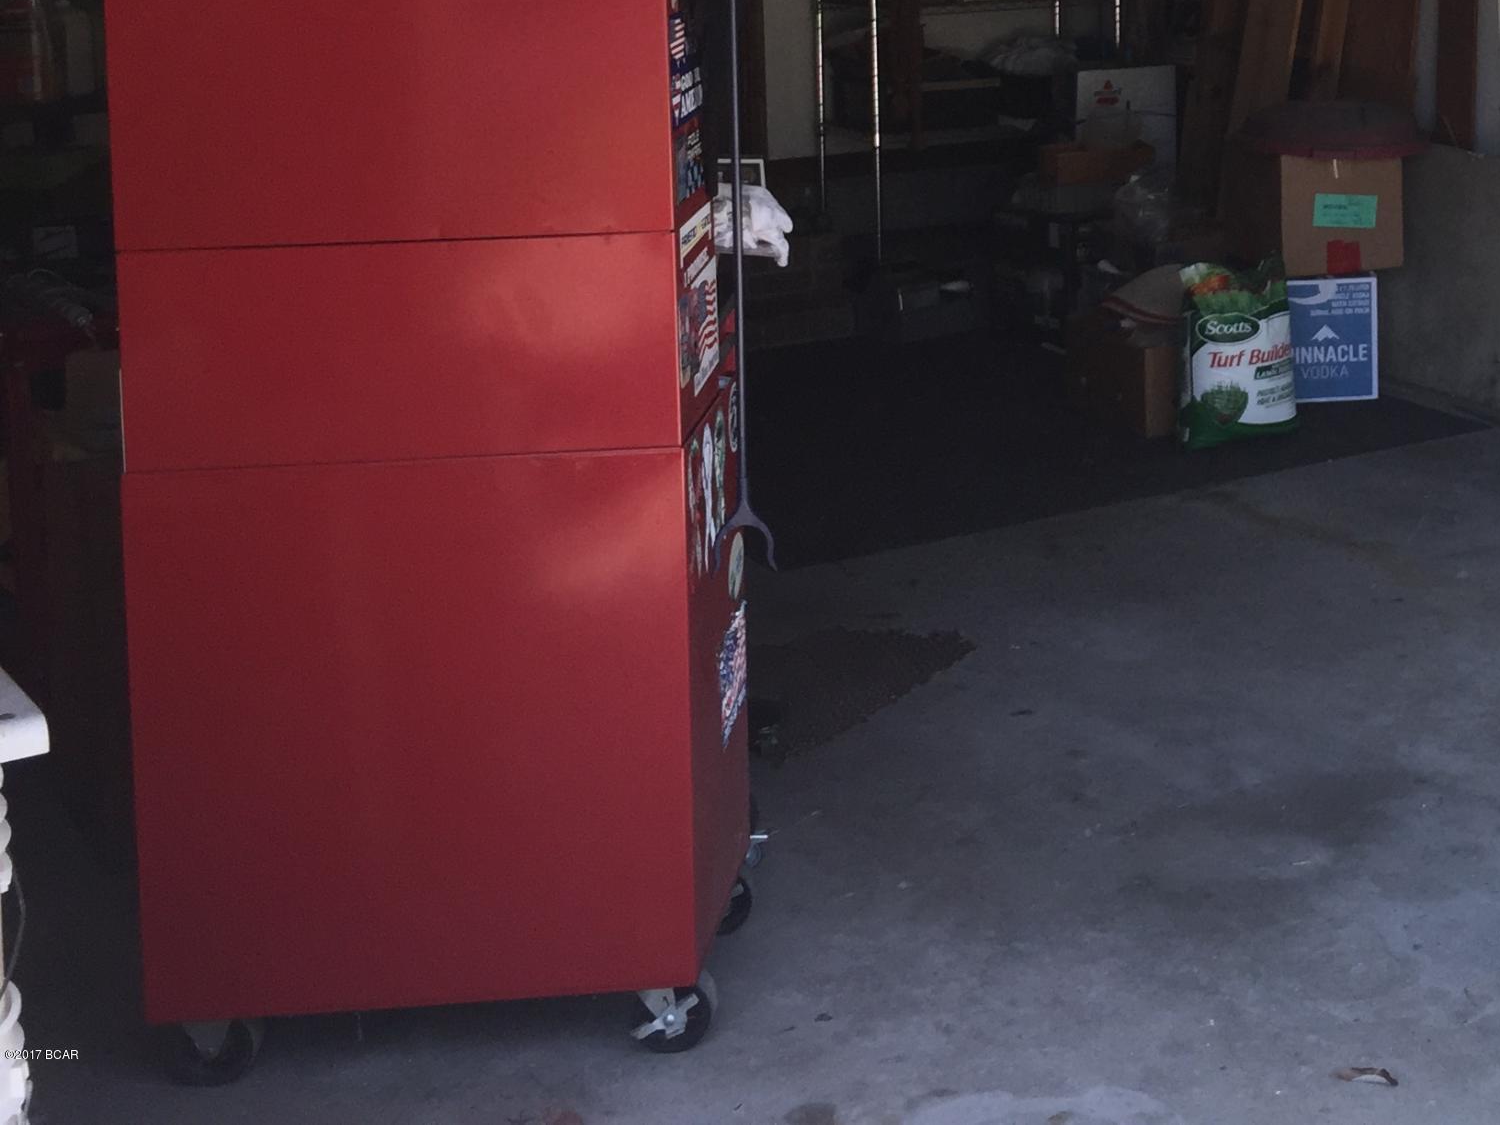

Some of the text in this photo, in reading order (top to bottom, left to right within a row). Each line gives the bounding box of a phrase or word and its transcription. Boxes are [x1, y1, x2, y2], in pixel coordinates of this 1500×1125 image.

[1204, 320, 1253, 336] Scotts
[1208, 342, 1291, 369] Turf Builde
[1300, 364, 1349, 380] VODKA
